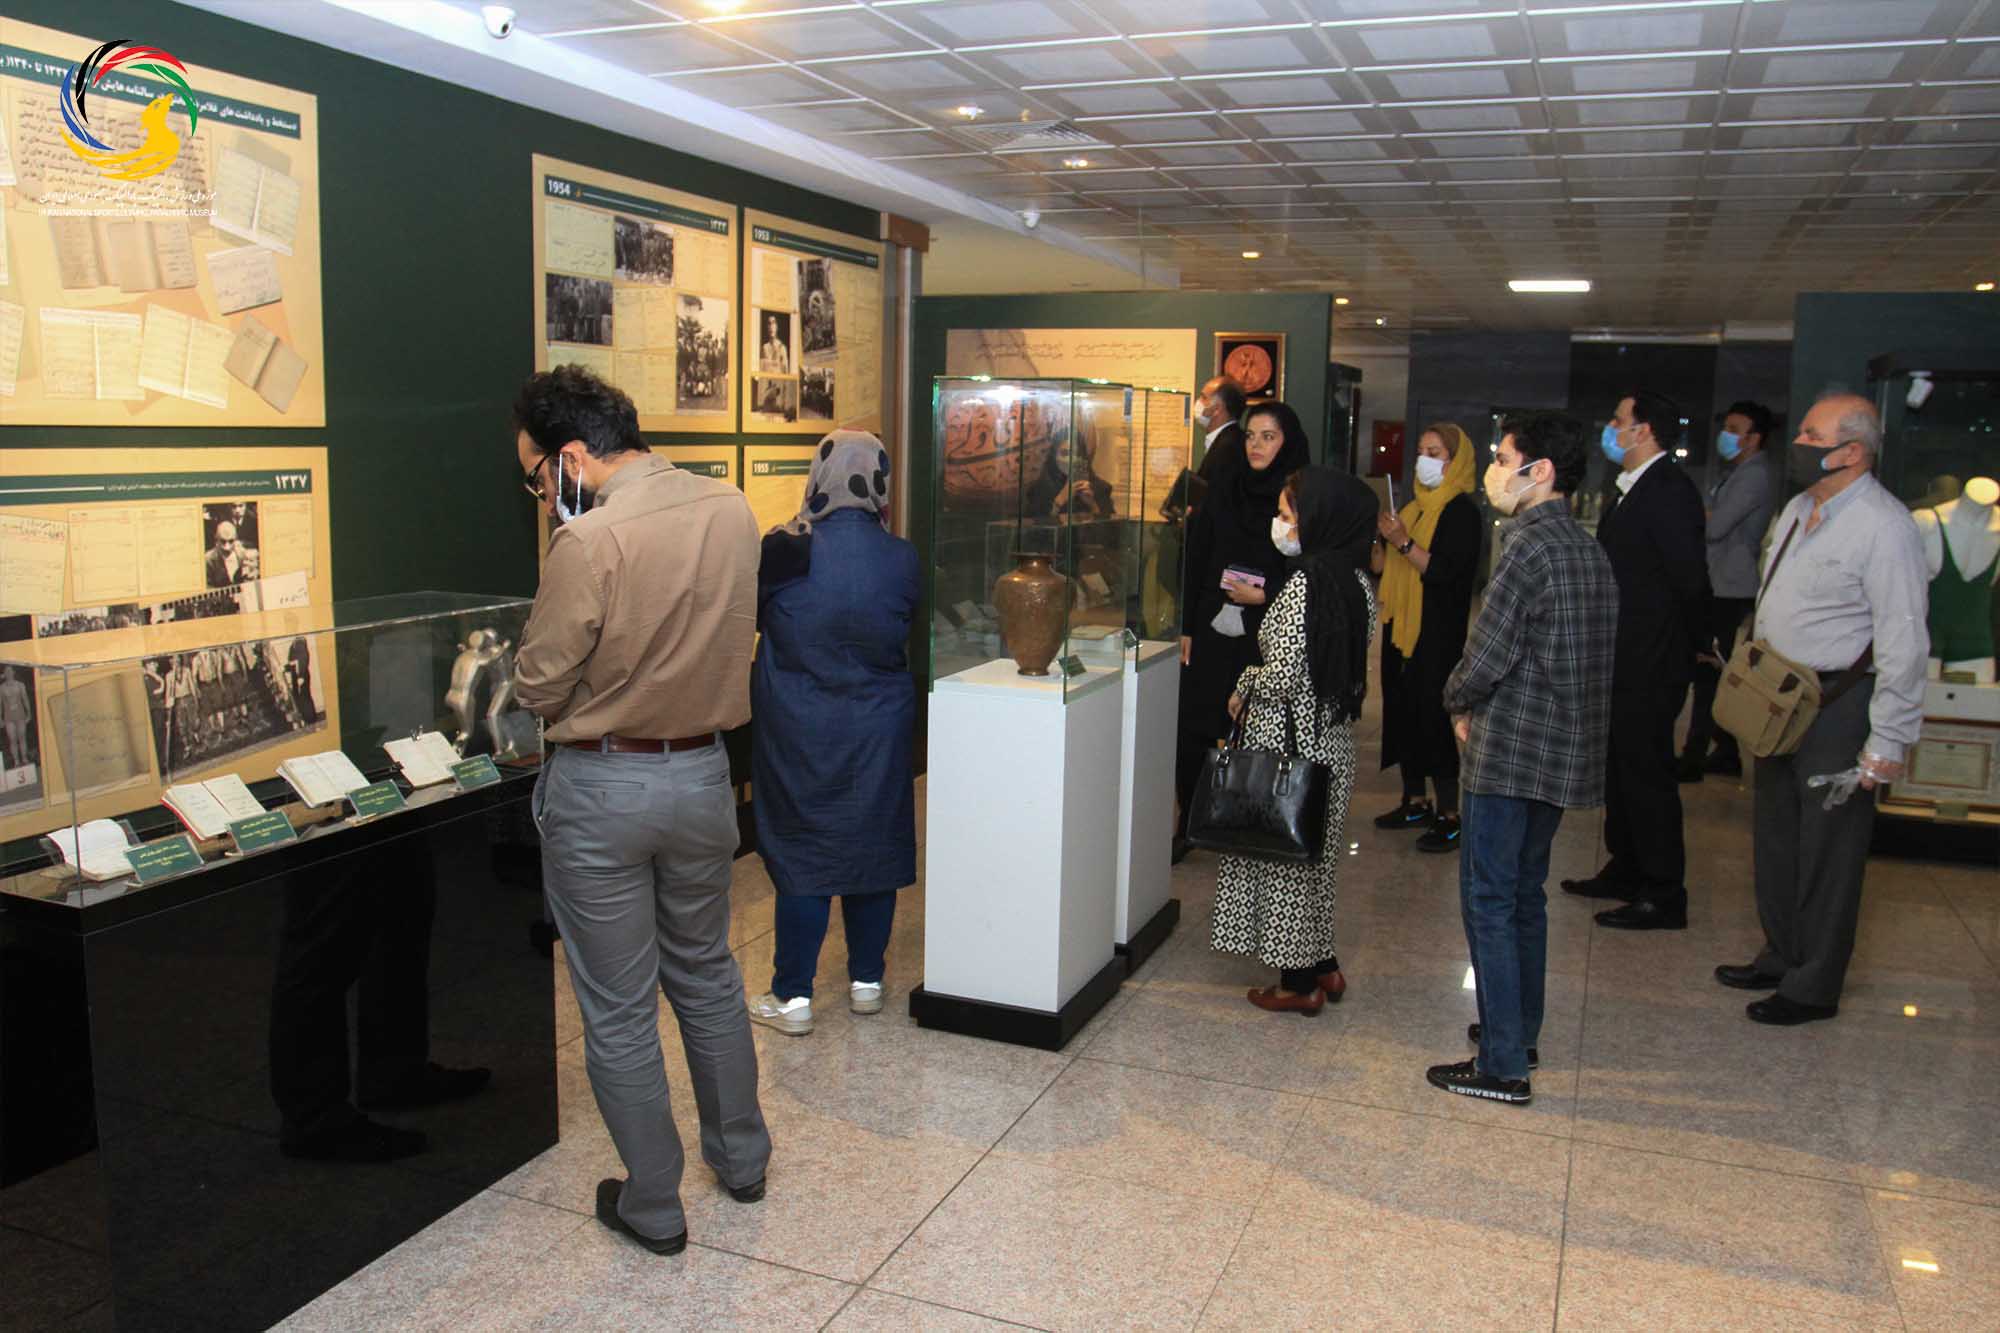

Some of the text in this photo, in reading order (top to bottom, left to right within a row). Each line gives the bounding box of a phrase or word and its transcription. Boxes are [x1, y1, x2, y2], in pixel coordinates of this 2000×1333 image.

[547, 178, 571, 197] 1954
[275, 474, 307, 490] ۱۳۳۷
[1447, 1085, 1513, 1101] CONVERSE
